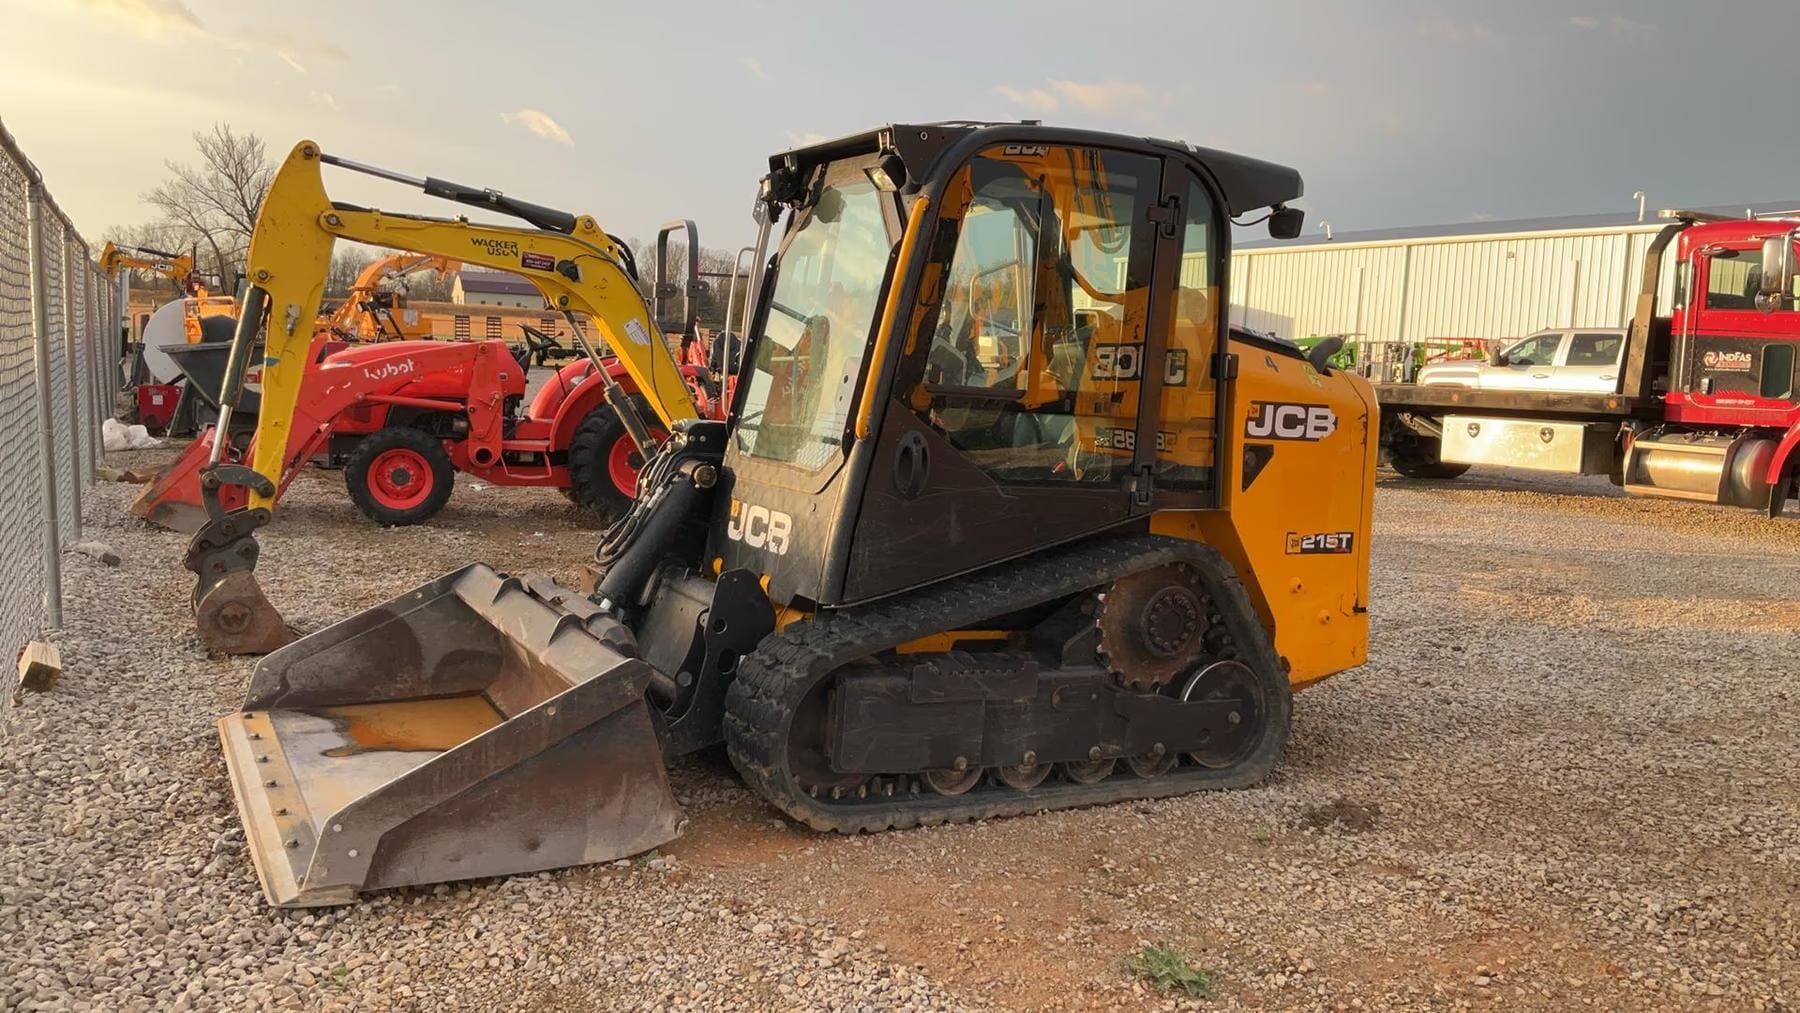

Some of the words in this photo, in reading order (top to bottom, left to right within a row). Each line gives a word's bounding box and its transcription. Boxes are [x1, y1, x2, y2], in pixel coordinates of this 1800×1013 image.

[471, 238, 519, 250] WACKER
[1247, 404, 1336, 439] JCB
[727, 502, 792, 556] JCB
[1302, 533, 1352, 549] 215T
